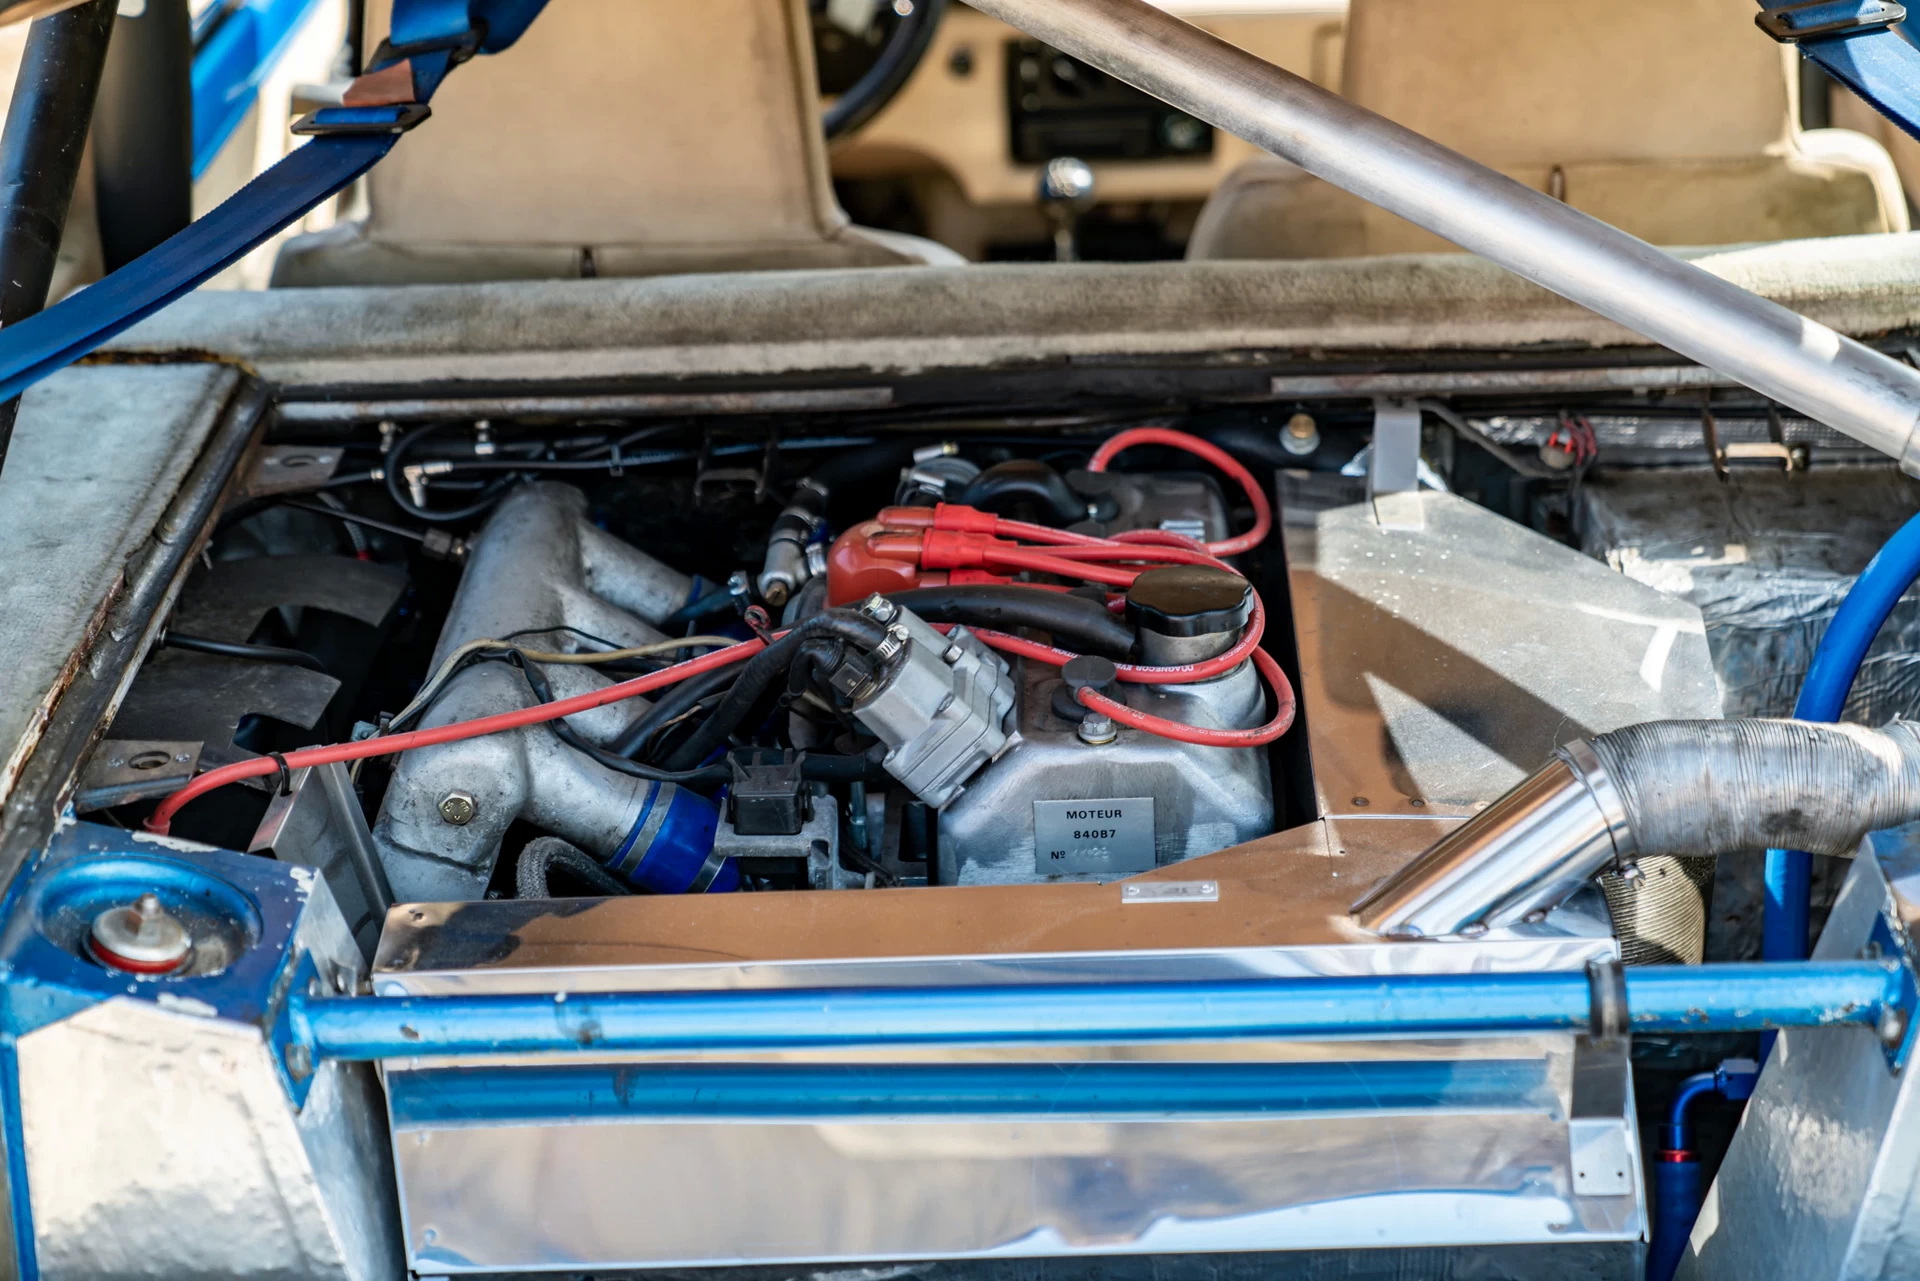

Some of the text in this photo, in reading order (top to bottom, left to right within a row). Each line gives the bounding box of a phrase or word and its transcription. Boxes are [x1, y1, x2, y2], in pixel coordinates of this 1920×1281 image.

[1135, 664, 1195, 673] MAGNECOR
[1066, 809, 1122, 819] MOTEUR
[1073, 829, 1116, 839] 840B7
